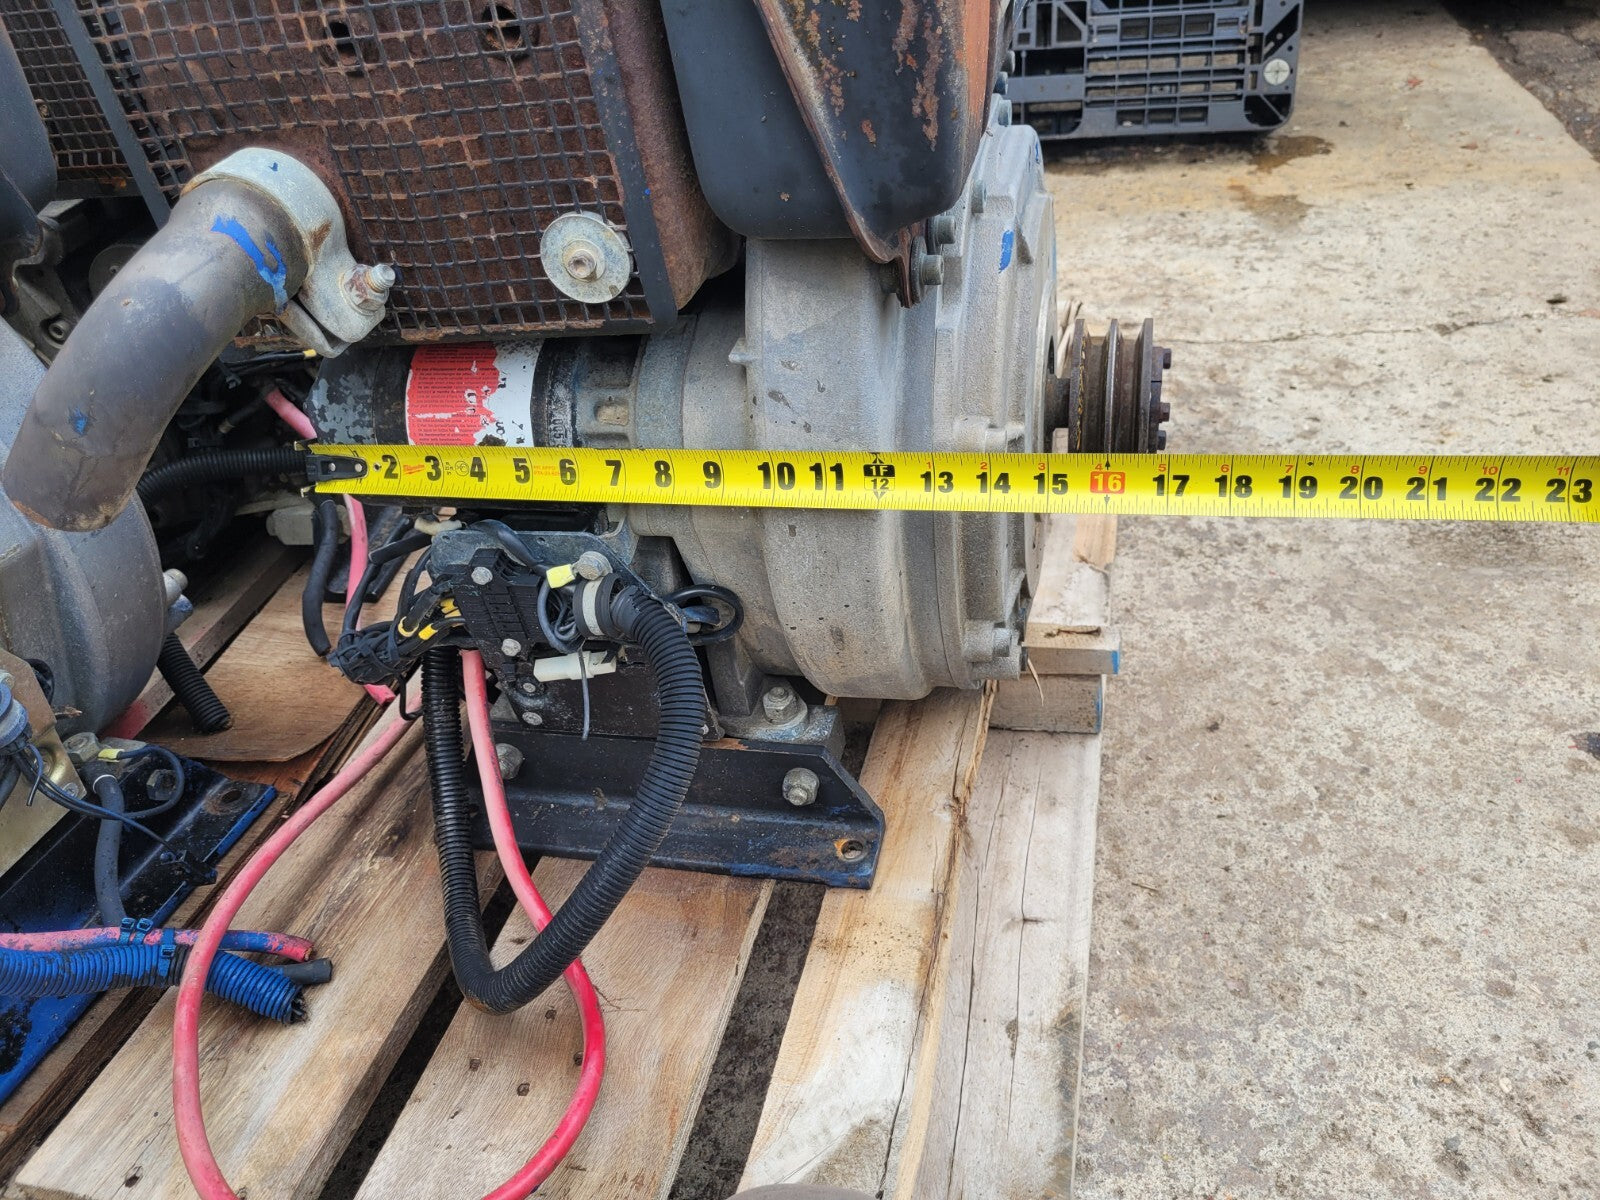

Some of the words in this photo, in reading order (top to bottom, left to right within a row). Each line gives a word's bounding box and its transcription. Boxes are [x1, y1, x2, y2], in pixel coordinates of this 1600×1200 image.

[381, 454, 398, 479] 2
[424, 455, 441, 481] 3
[470, 457, 486, 482] 4
[512, 458, 530, 484] 5
[559, 459, 577, 486] 6
[605, 460, 622, 487] 7
[654, 460, 672, 488] 8
[702, 461, 722, 489] 9
[757, 462, 796, 491] 10
[809, 462, 844, 491] 11
[870, 478, 889, 490] 12
[920, 471, 954, 493] 13
[976, 472, 1011, 494] 14
[1033, 473, 1068, 495] 15
[1091, 473, 1123, 493] 16
[1152, 474, 1190, 497] 17
[1214, 474, 1253, 499] 18
[1278, 475, 1318, 499] 19
[1338, 476, 1384, 500] 20
[1405, 476, 1448, 500] 21
[1474, 477, 1522, 502] 22
[1544, 478, 1593, 503] 23
[870, 465, 889, 476] 1F
[925, 462, 932, 470] 1
[979, 462, 988, 470] 2
[1037, 462, 1046, 471] 3
[1094, 463, 1104, 471] 4
[1157, 463, 1167, 472] 5
[1220, 464, 1230, 473] 6
[1285, 464, 1294, 474] 7
[1350, 465, 1360, 474] 8
[1418, 465, 1428, 475] 9
[1482, 466, 1499, 475] 10
[1556, 466, 1571, 476] 11
